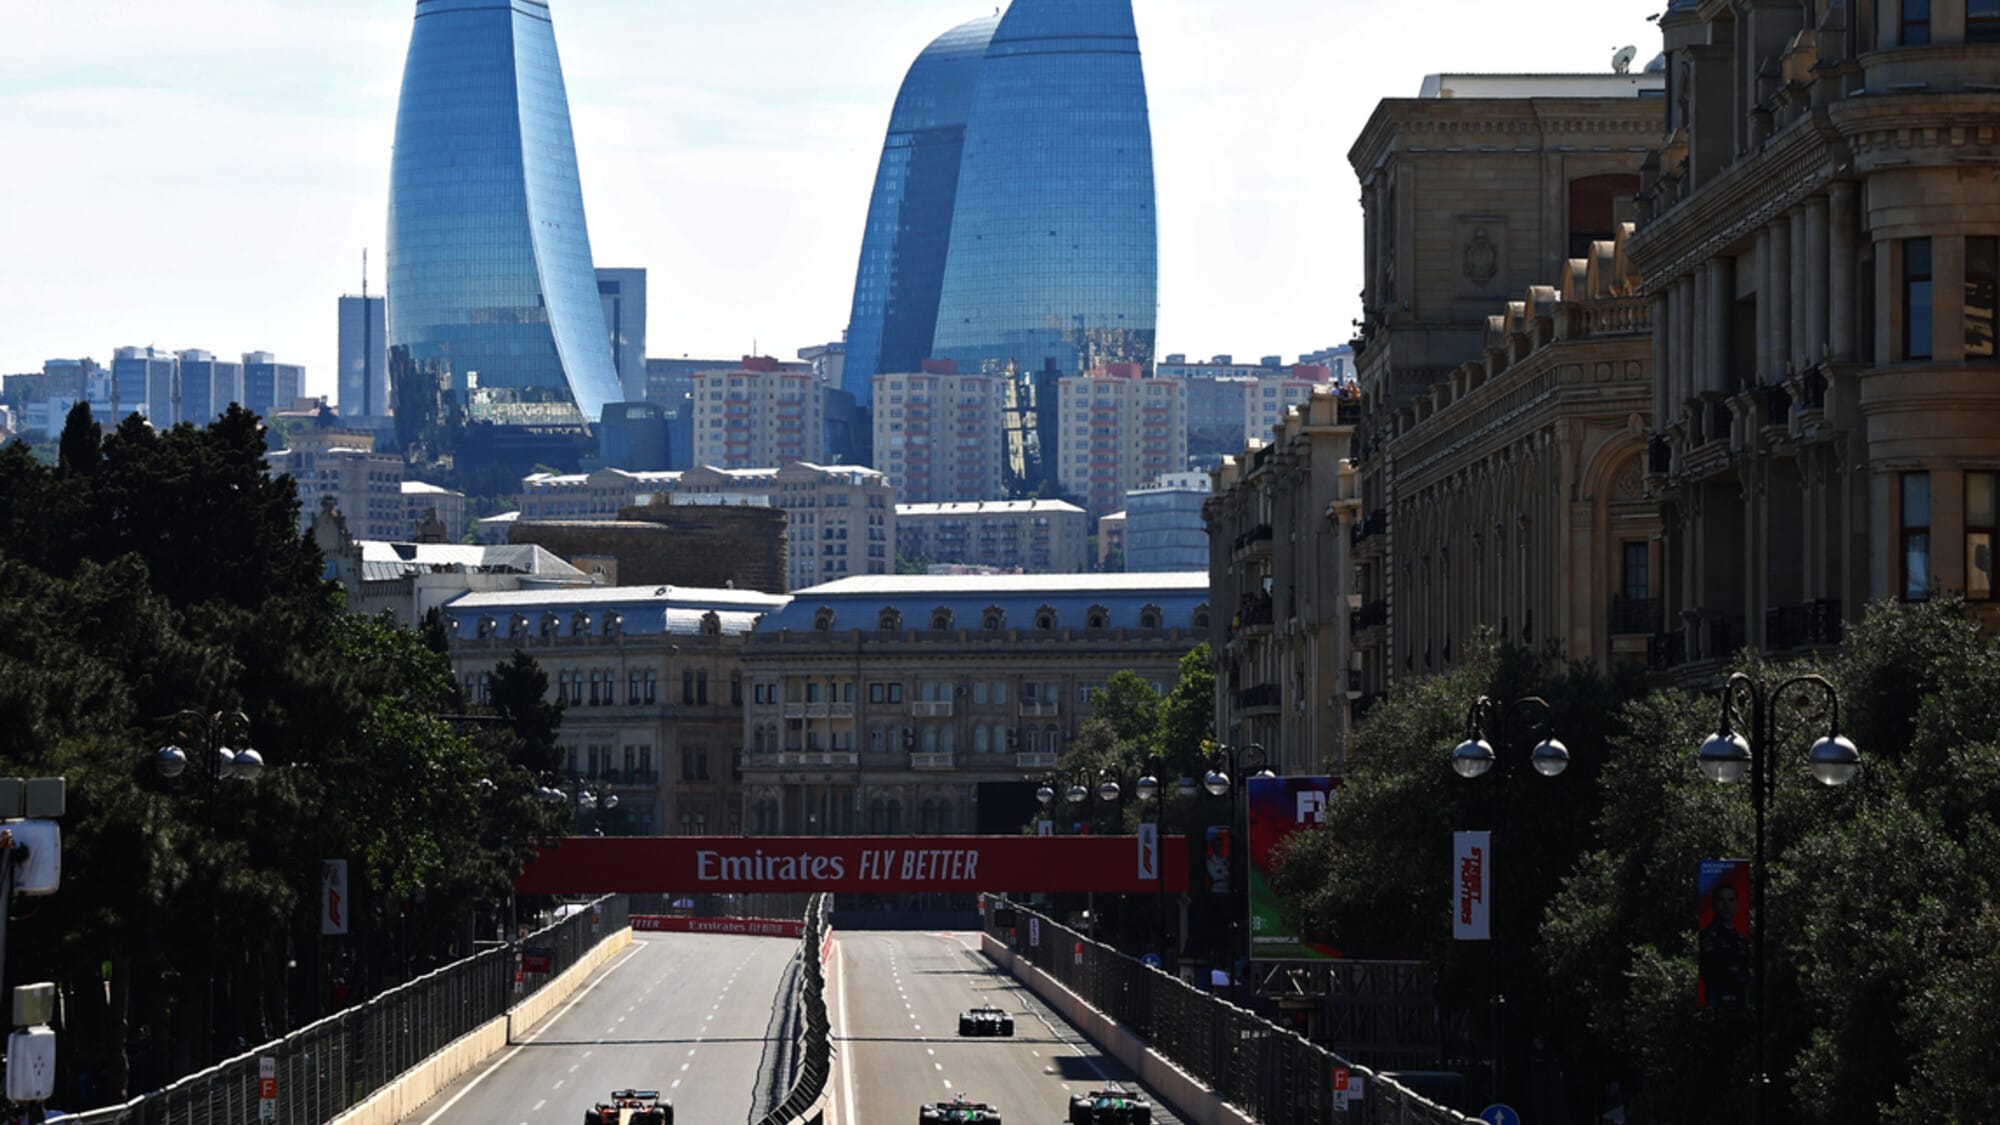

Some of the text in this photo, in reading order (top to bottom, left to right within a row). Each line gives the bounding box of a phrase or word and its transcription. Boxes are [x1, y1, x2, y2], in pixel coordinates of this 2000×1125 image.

[696, 850, 979, 880] Emirates FLY BETTER
[688, 921, 745, 933] Emirates
[263, 1080, 273, 1096] F
[1335, 1072, 1344, 1088] F
